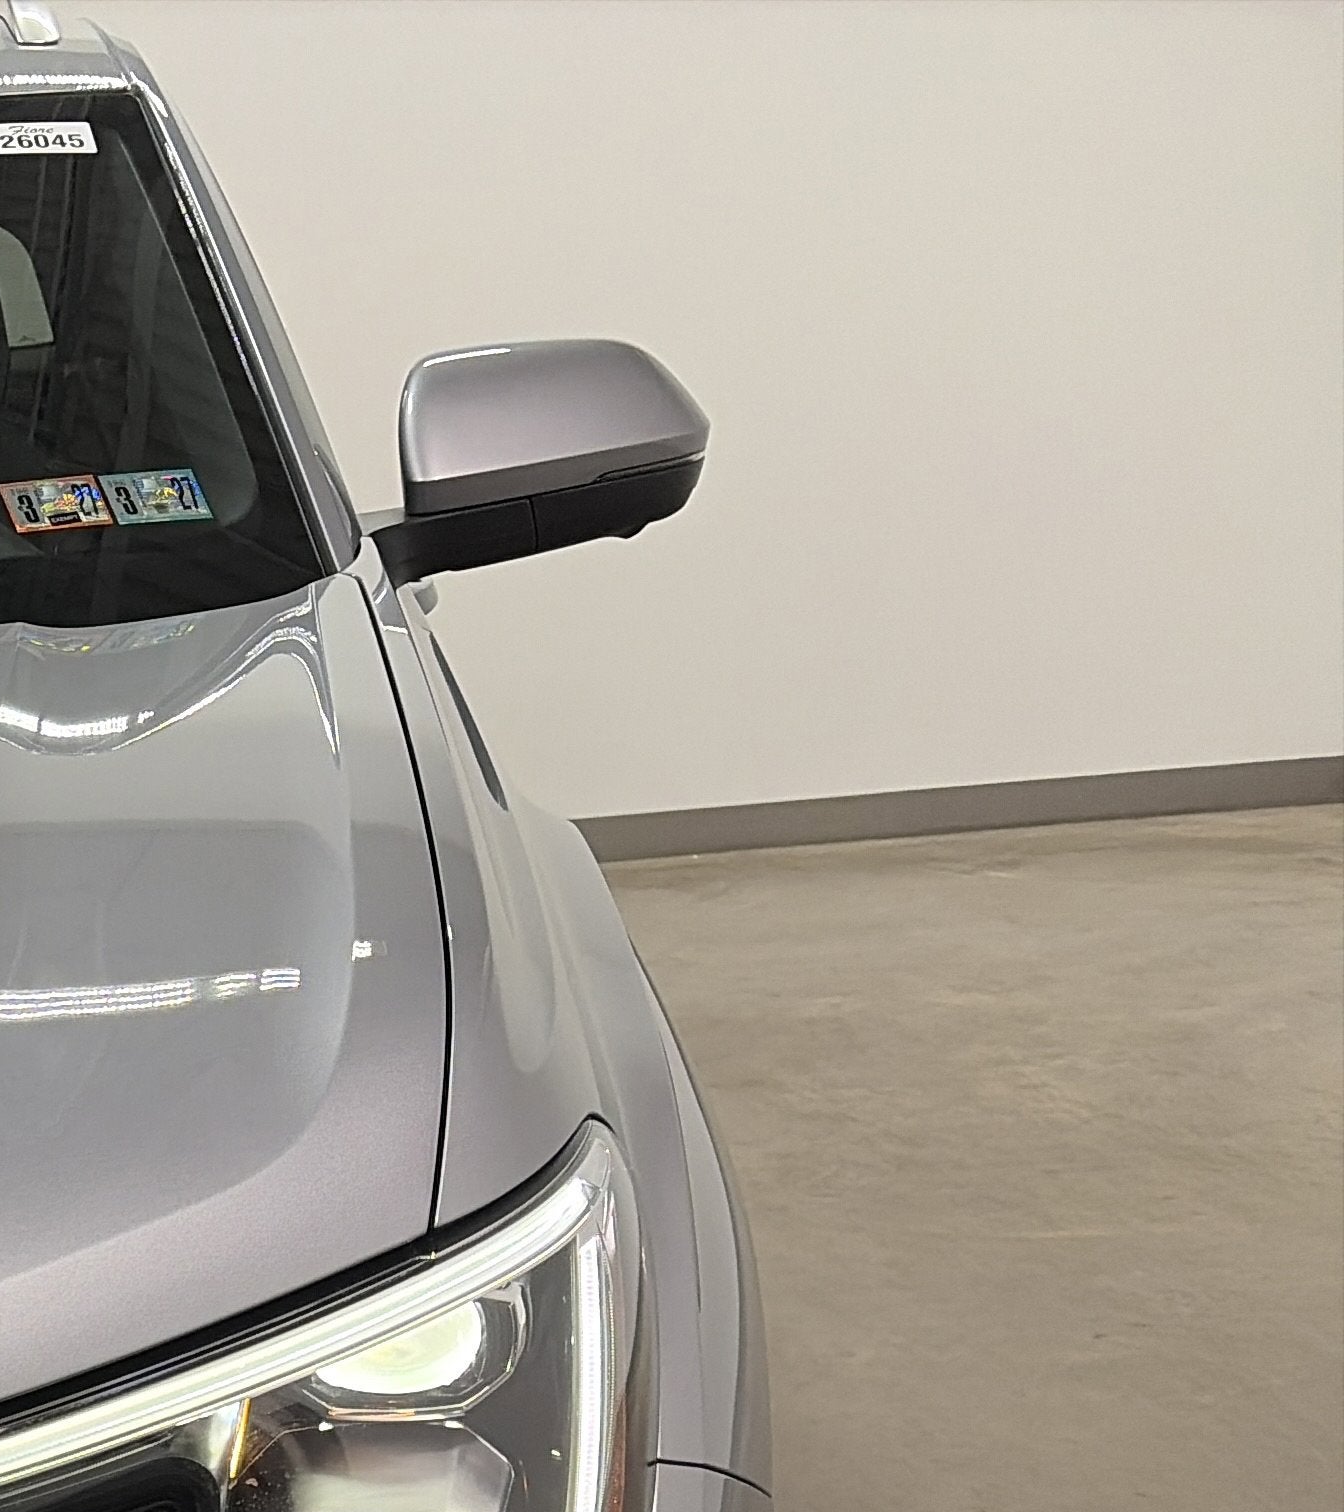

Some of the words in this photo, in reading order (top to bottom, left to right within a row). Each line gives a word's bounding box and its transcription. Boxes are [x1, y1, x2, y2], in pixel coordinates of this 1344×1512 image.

[17, 495, 40, 523] 3
[71, 483, 99, 516] 27
[115, 487, 138, 514] 3
[169, 477, 199, 510] 27
